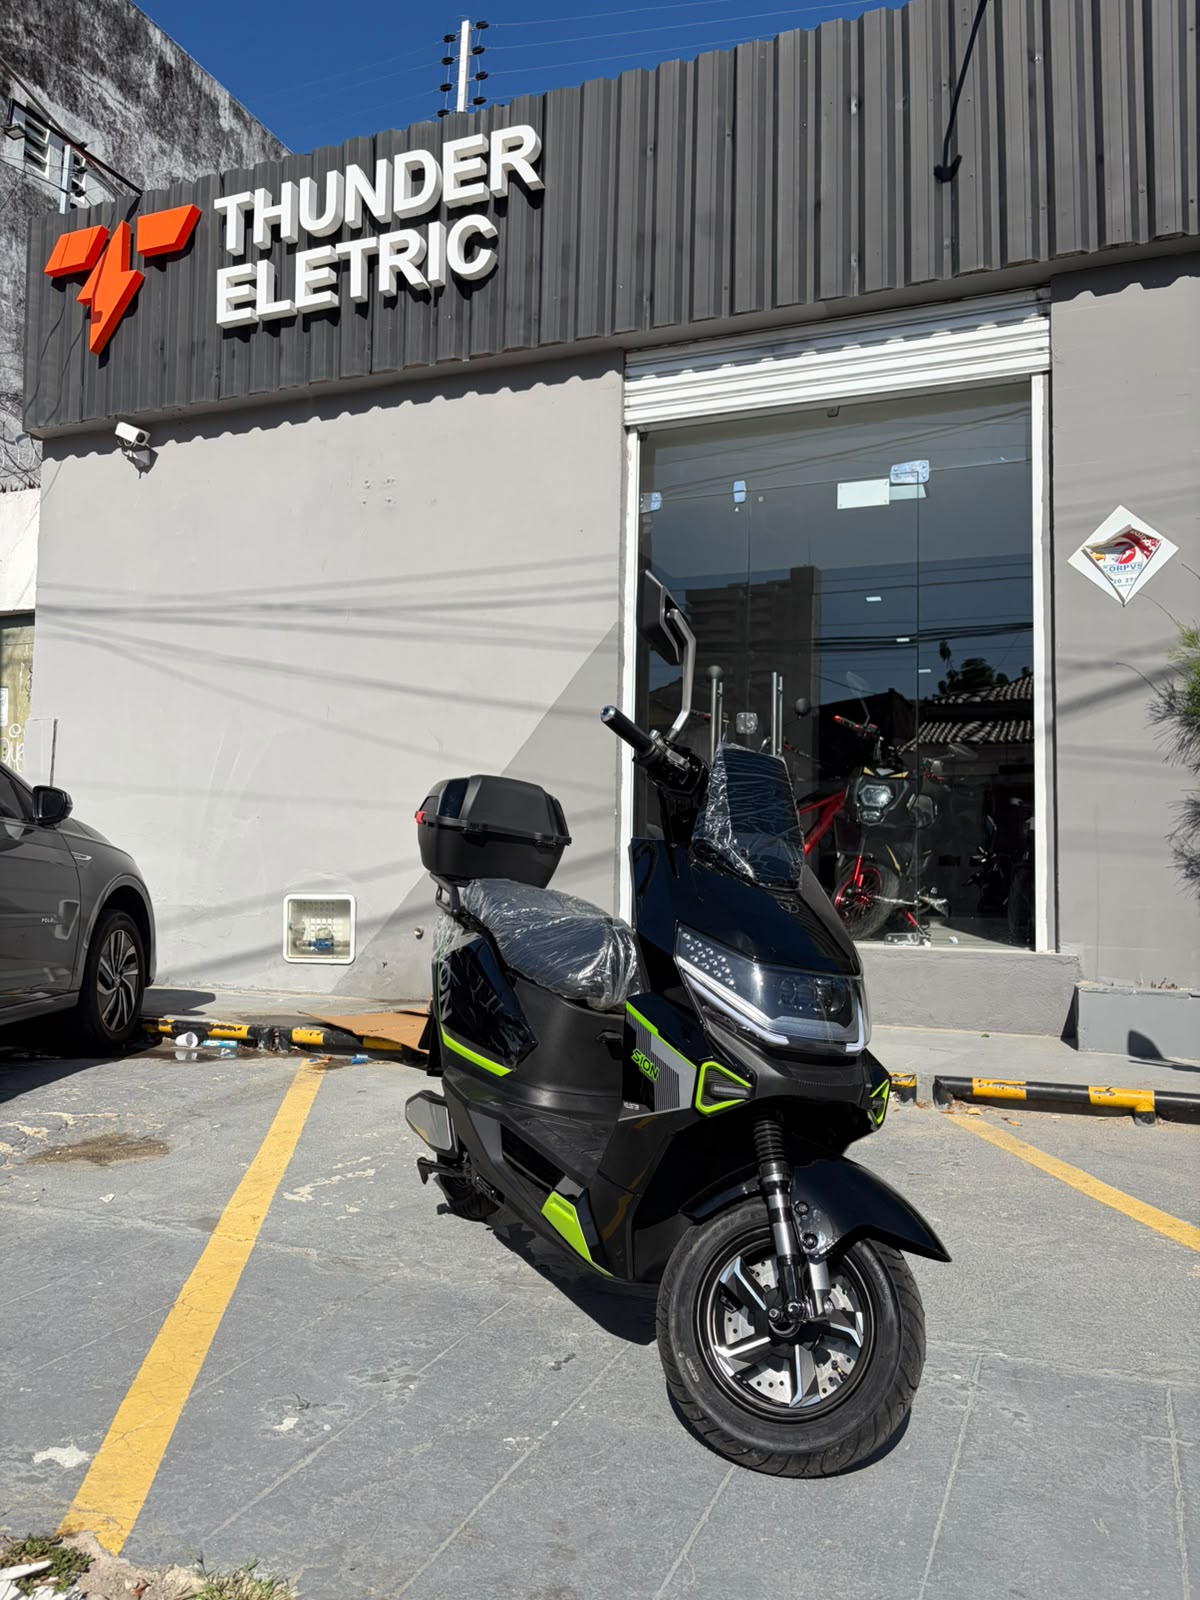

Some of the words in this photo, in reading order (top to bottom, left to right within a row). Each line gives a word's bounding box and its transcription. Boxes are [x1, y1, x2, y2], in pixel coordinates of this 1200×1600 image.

[214, 125, 545, 256] THUNDER
[216, 214, 498, 329] ELETRIC
[631, 1049, 660, 1081] SION
